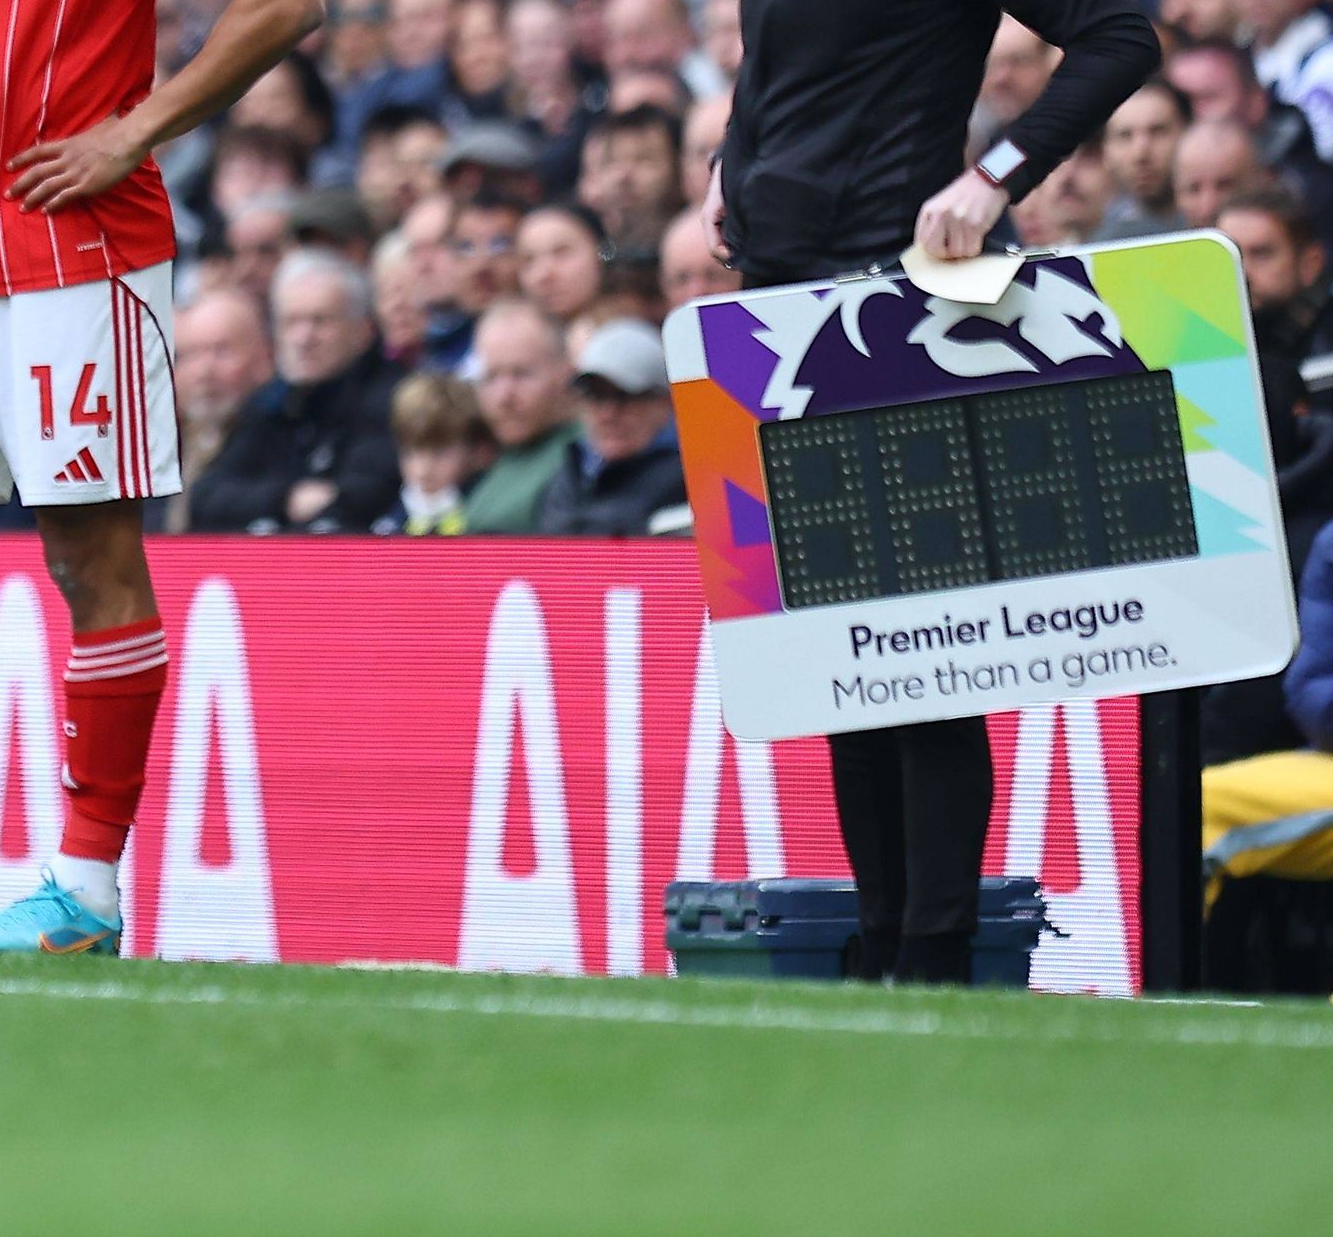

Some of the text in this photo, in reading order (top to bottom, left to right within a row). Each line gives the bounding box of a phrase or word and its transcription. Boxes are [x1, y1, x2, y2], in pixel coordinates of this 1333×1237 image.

[30, 362, 112, 440] 14
[849, 597, 1145, 659] Premier League
[832, 641, 1179, 709] More than a game.
